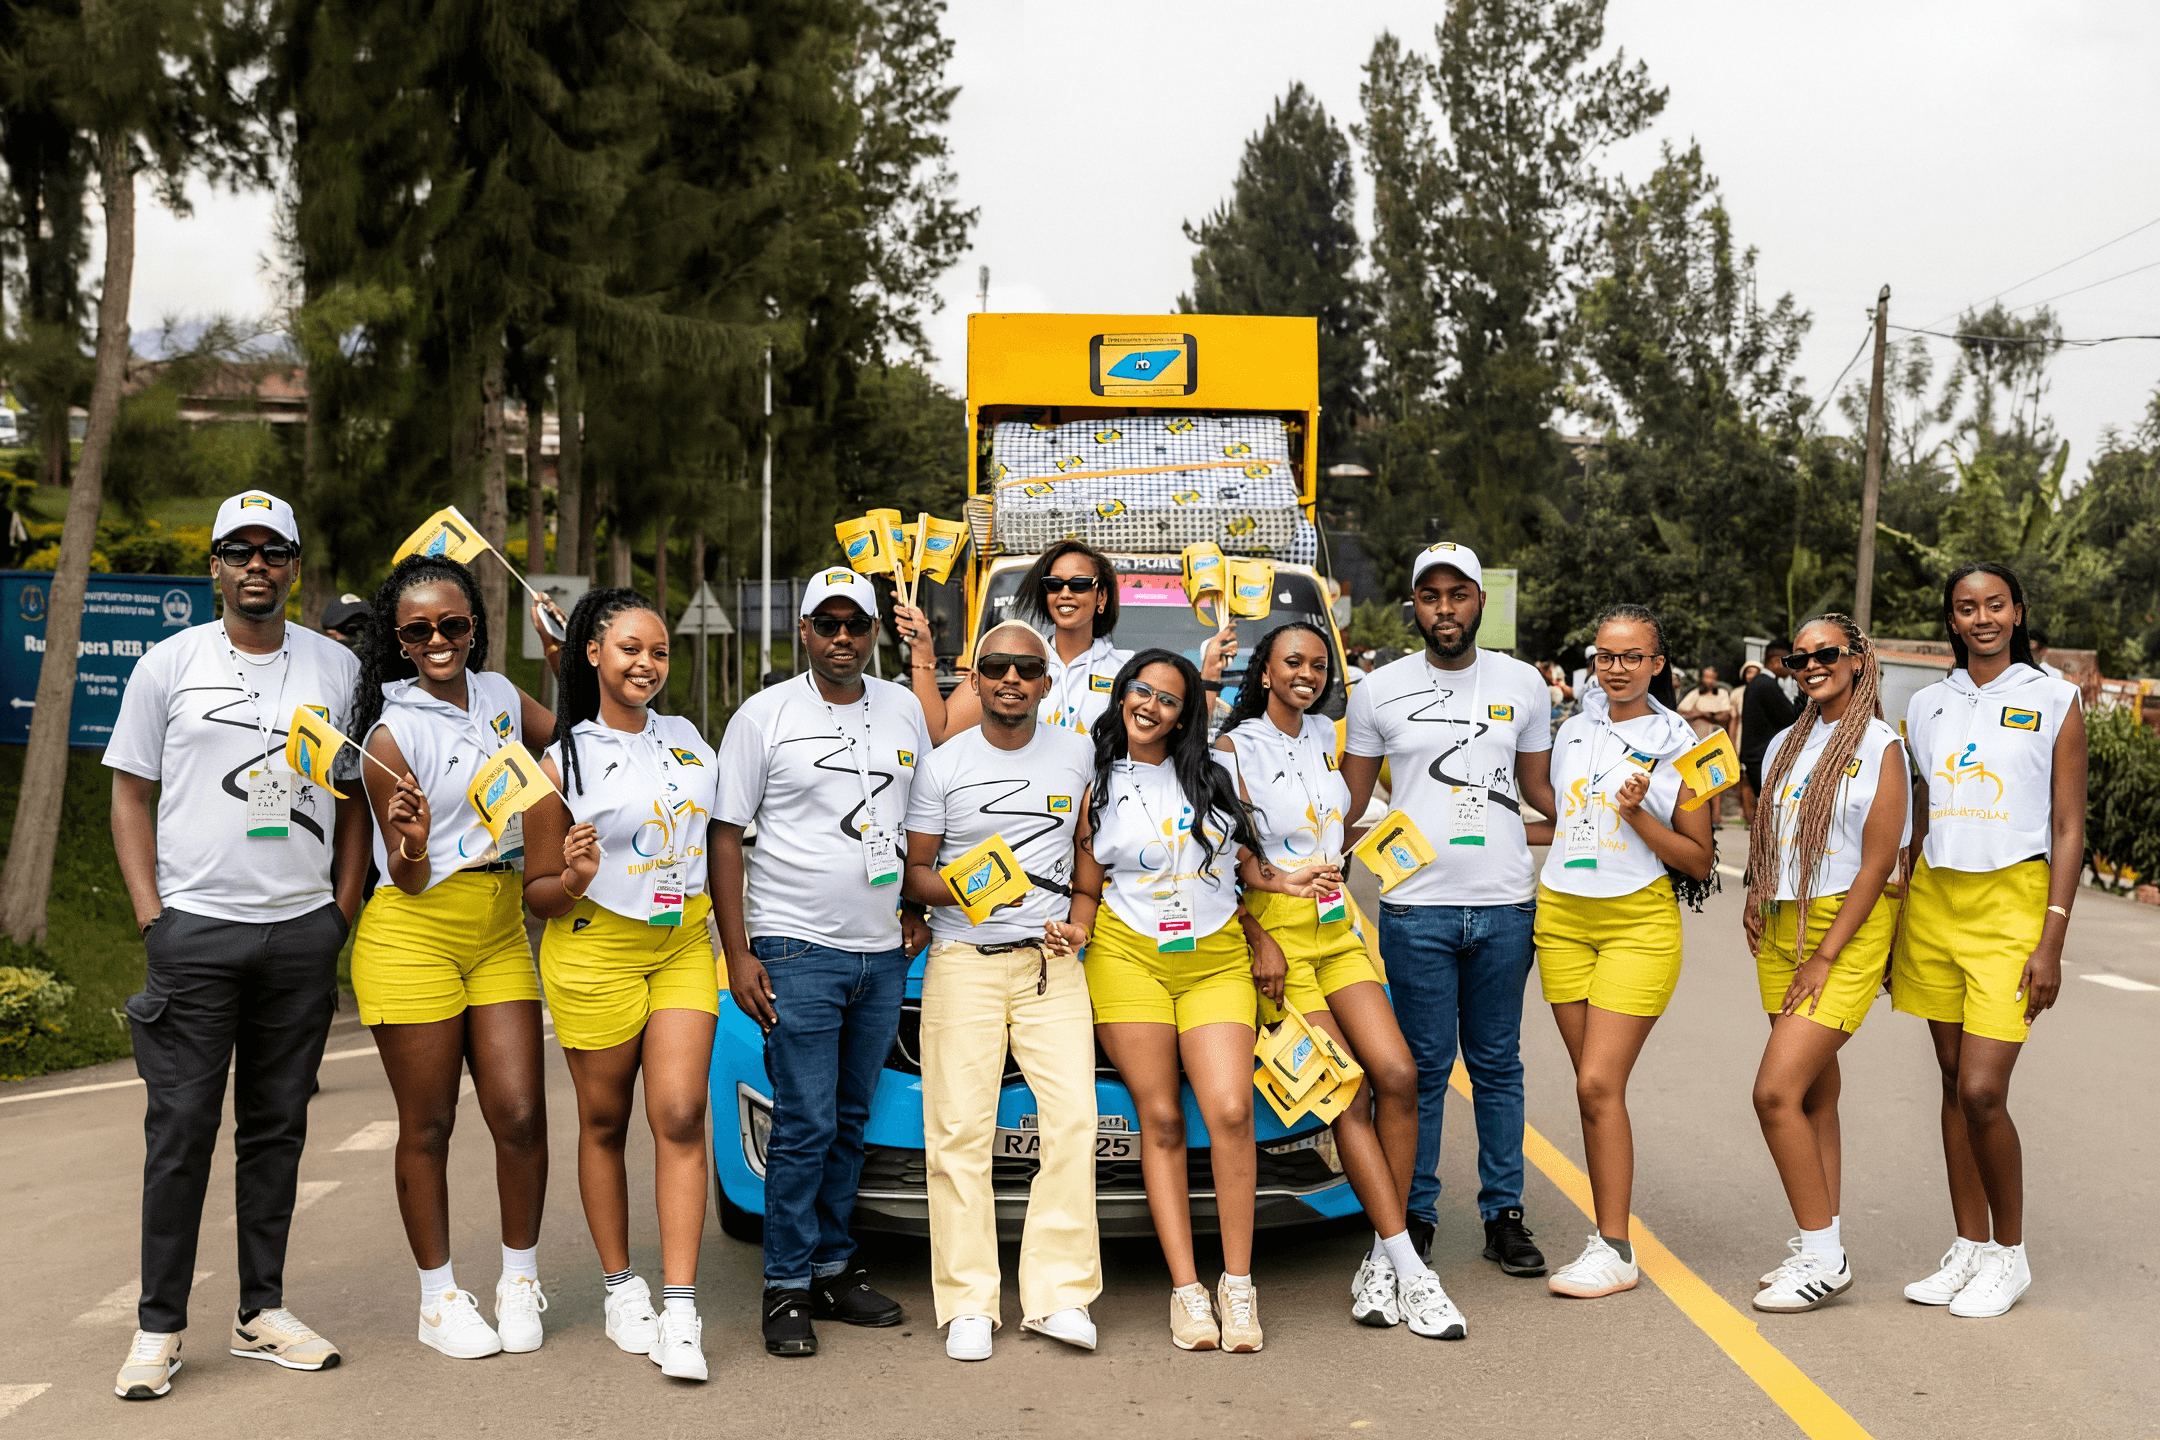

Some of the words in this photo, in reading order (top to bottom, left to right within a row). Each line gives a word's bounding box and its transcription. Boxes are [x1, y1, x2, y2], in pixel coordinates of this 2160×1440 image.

[24, 634, 109, 658] Rugera
[1004, 1135, 1040, 1154] RA
[1095, 1138, 1131, 1157] 25
